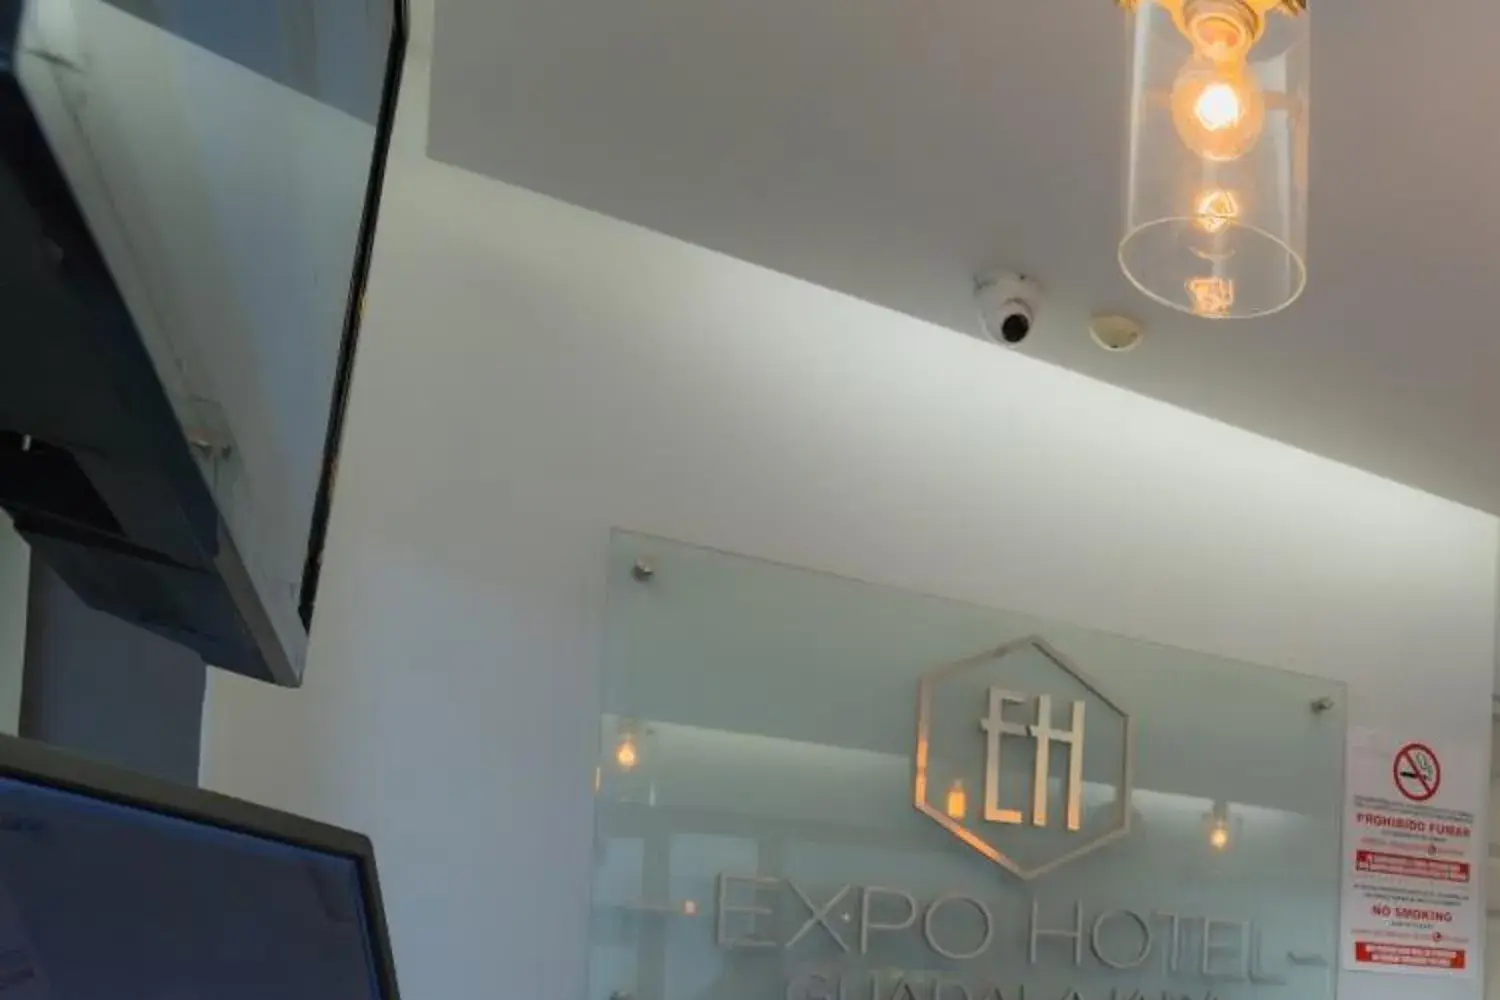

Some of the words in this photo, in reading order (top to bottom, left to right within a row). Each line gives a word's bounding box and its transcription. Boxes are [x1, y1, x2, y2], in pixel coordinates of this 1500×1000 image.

[1356, 812, 1425, 832] PROHIBIDO
[1429, 822, 1471, 838] FUMAR
[1371, 903, 1391, 918] NO
[1395, 907, 1453, 922] SMOKING
[716, 872, 993, 960] EXPO
[1028, 897, 1287, 985] HOTEL
